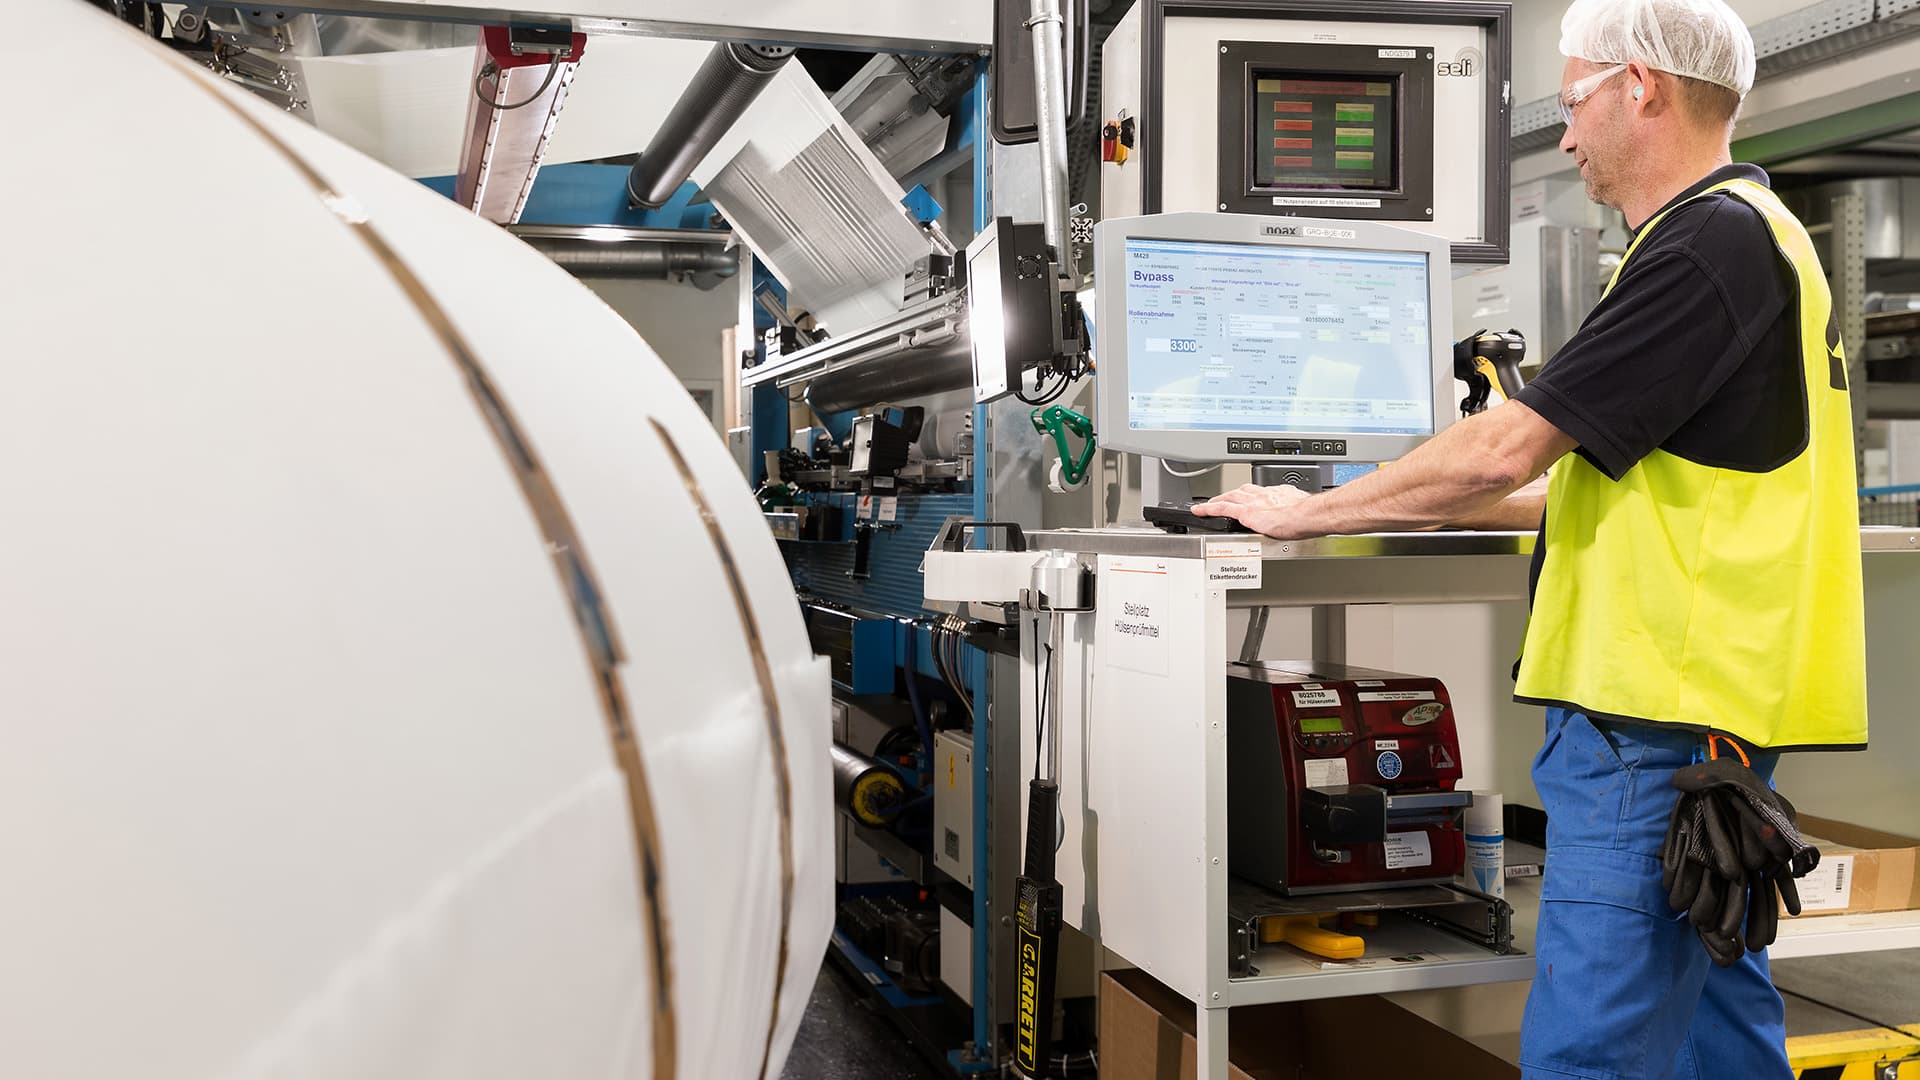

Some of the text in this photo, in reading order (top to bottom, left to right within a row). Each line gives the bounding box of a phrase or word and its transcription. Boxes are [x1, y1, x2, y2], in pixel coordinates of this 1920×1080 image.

[1437, 58, 1472, 76] seli
[1266, 225, 1297, 236] noax
[1133, 270, 1175, 283] Bypass
[1170, 340, 1197, 352] 3300
[1124, 602, 1150, 618] Stellplatz
[1114, 620, 1160, 639] Hülsenprüfmittel
[1021, 944, 1036, 1062] GARRETT
